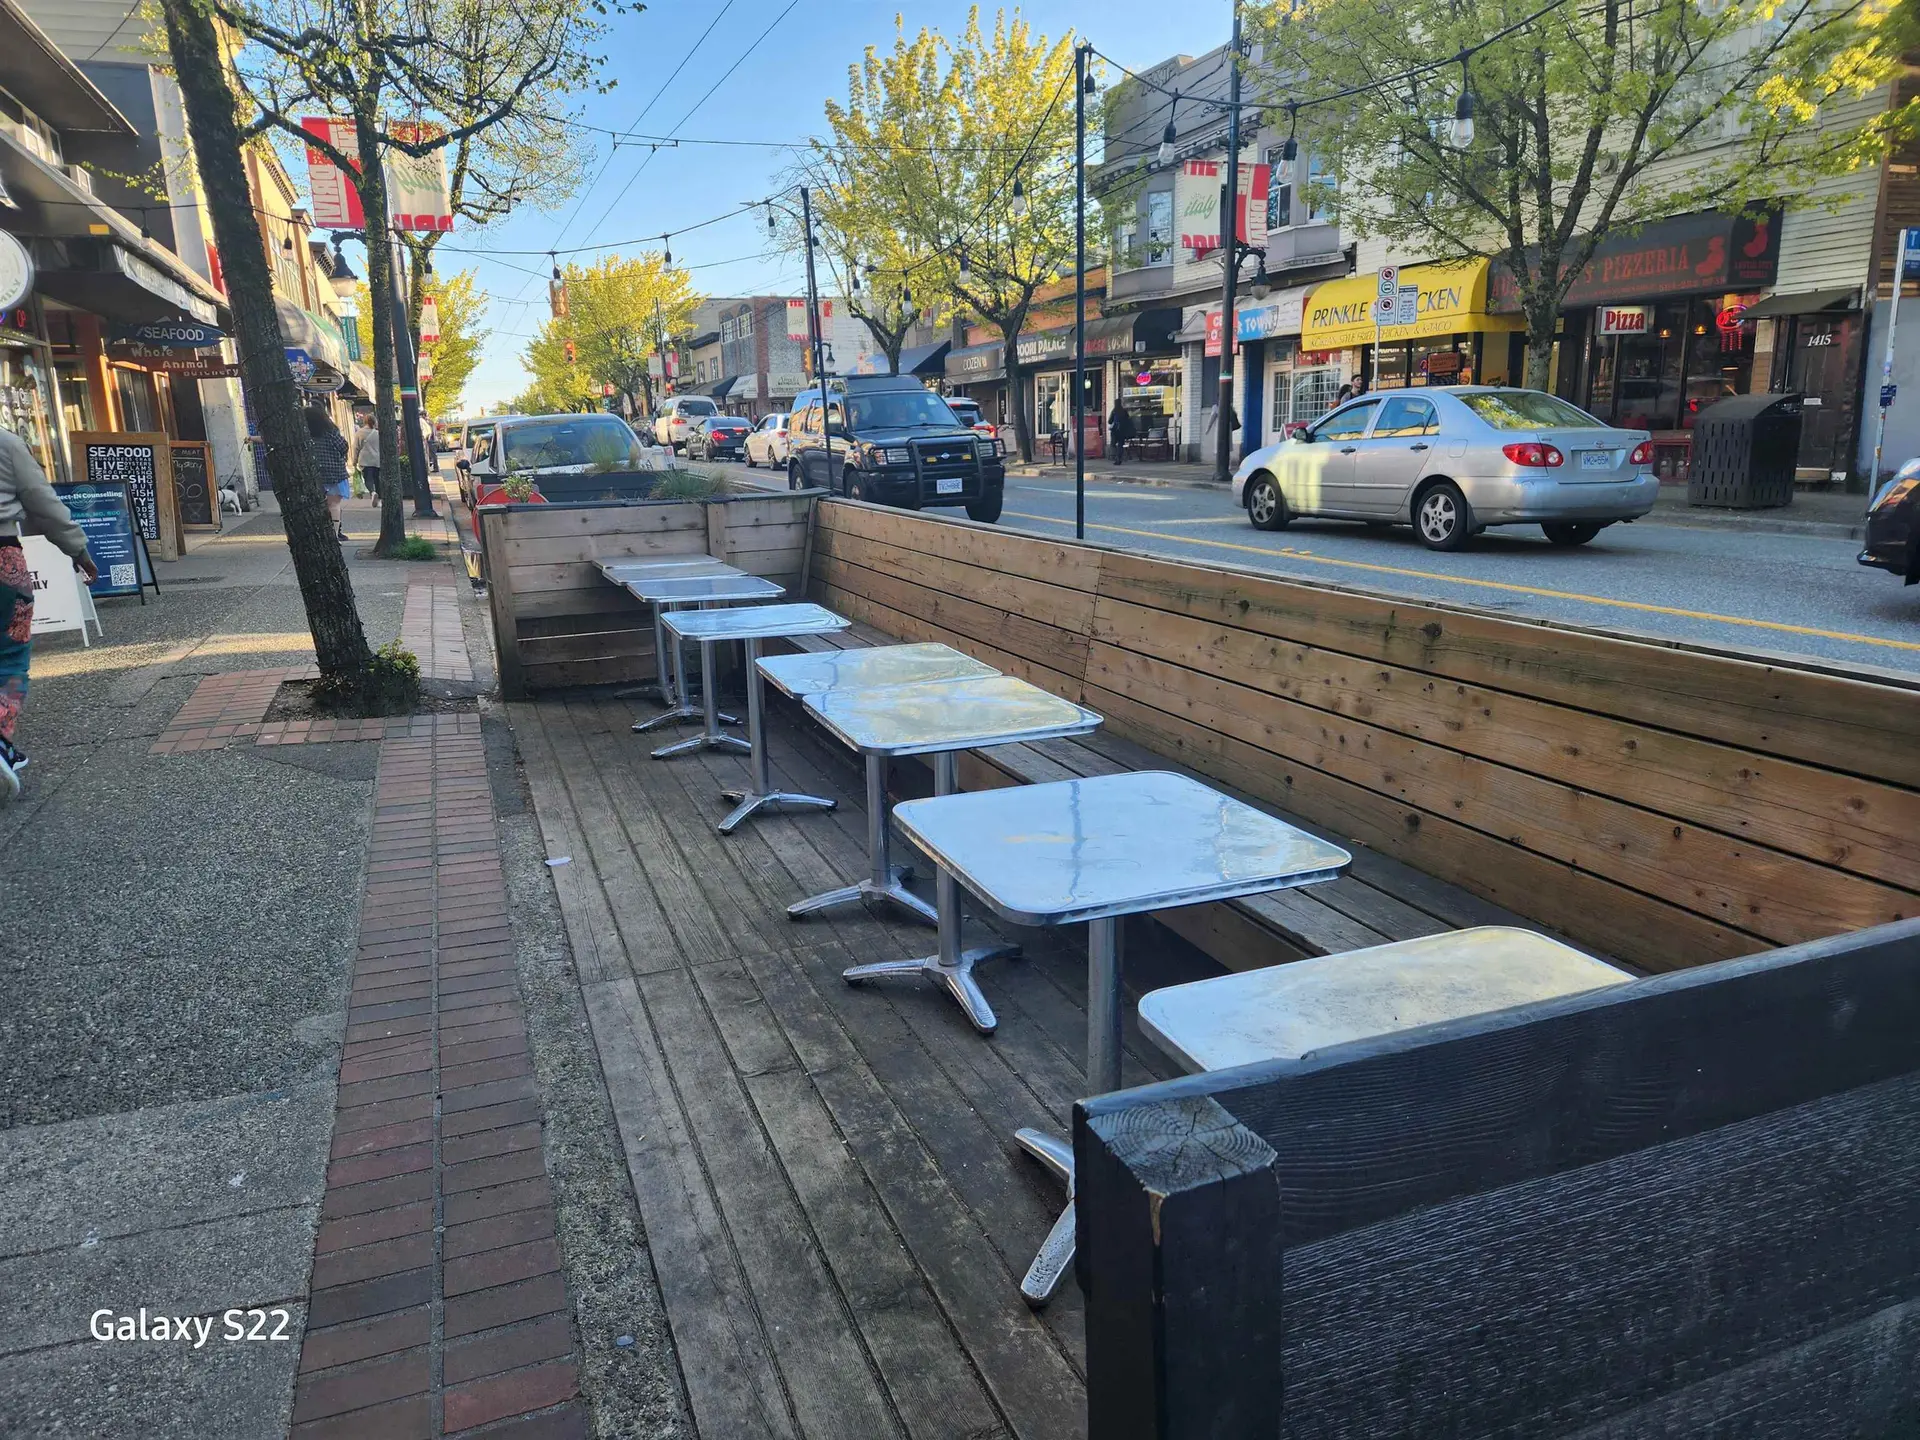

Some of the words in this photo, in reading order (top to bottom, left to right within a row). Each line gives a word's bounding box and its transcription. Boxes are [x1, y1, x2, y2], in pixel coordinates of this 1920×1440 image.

[1603, 244, 1690, 283] PIZZERIA
[1312, 302, 1368, 328] PRINKLE
[1417, 286, 1462, 313] CKEN
[1604, 310, 1645, 331] Pizza
[143, 326, 205, 341] SEAFOOD
[1807, 334, 1833, 347] 1415
[130, 347, 174, 357] Whole
[162, 360, 208, 369] Animal
[89, 446, 151, 457] SEAFOOD
[94, 461, 124, 470] LIVE
[82, 490, 123, 499] Counselling
[147, 498, 157, 538] SUSTAINABLE
